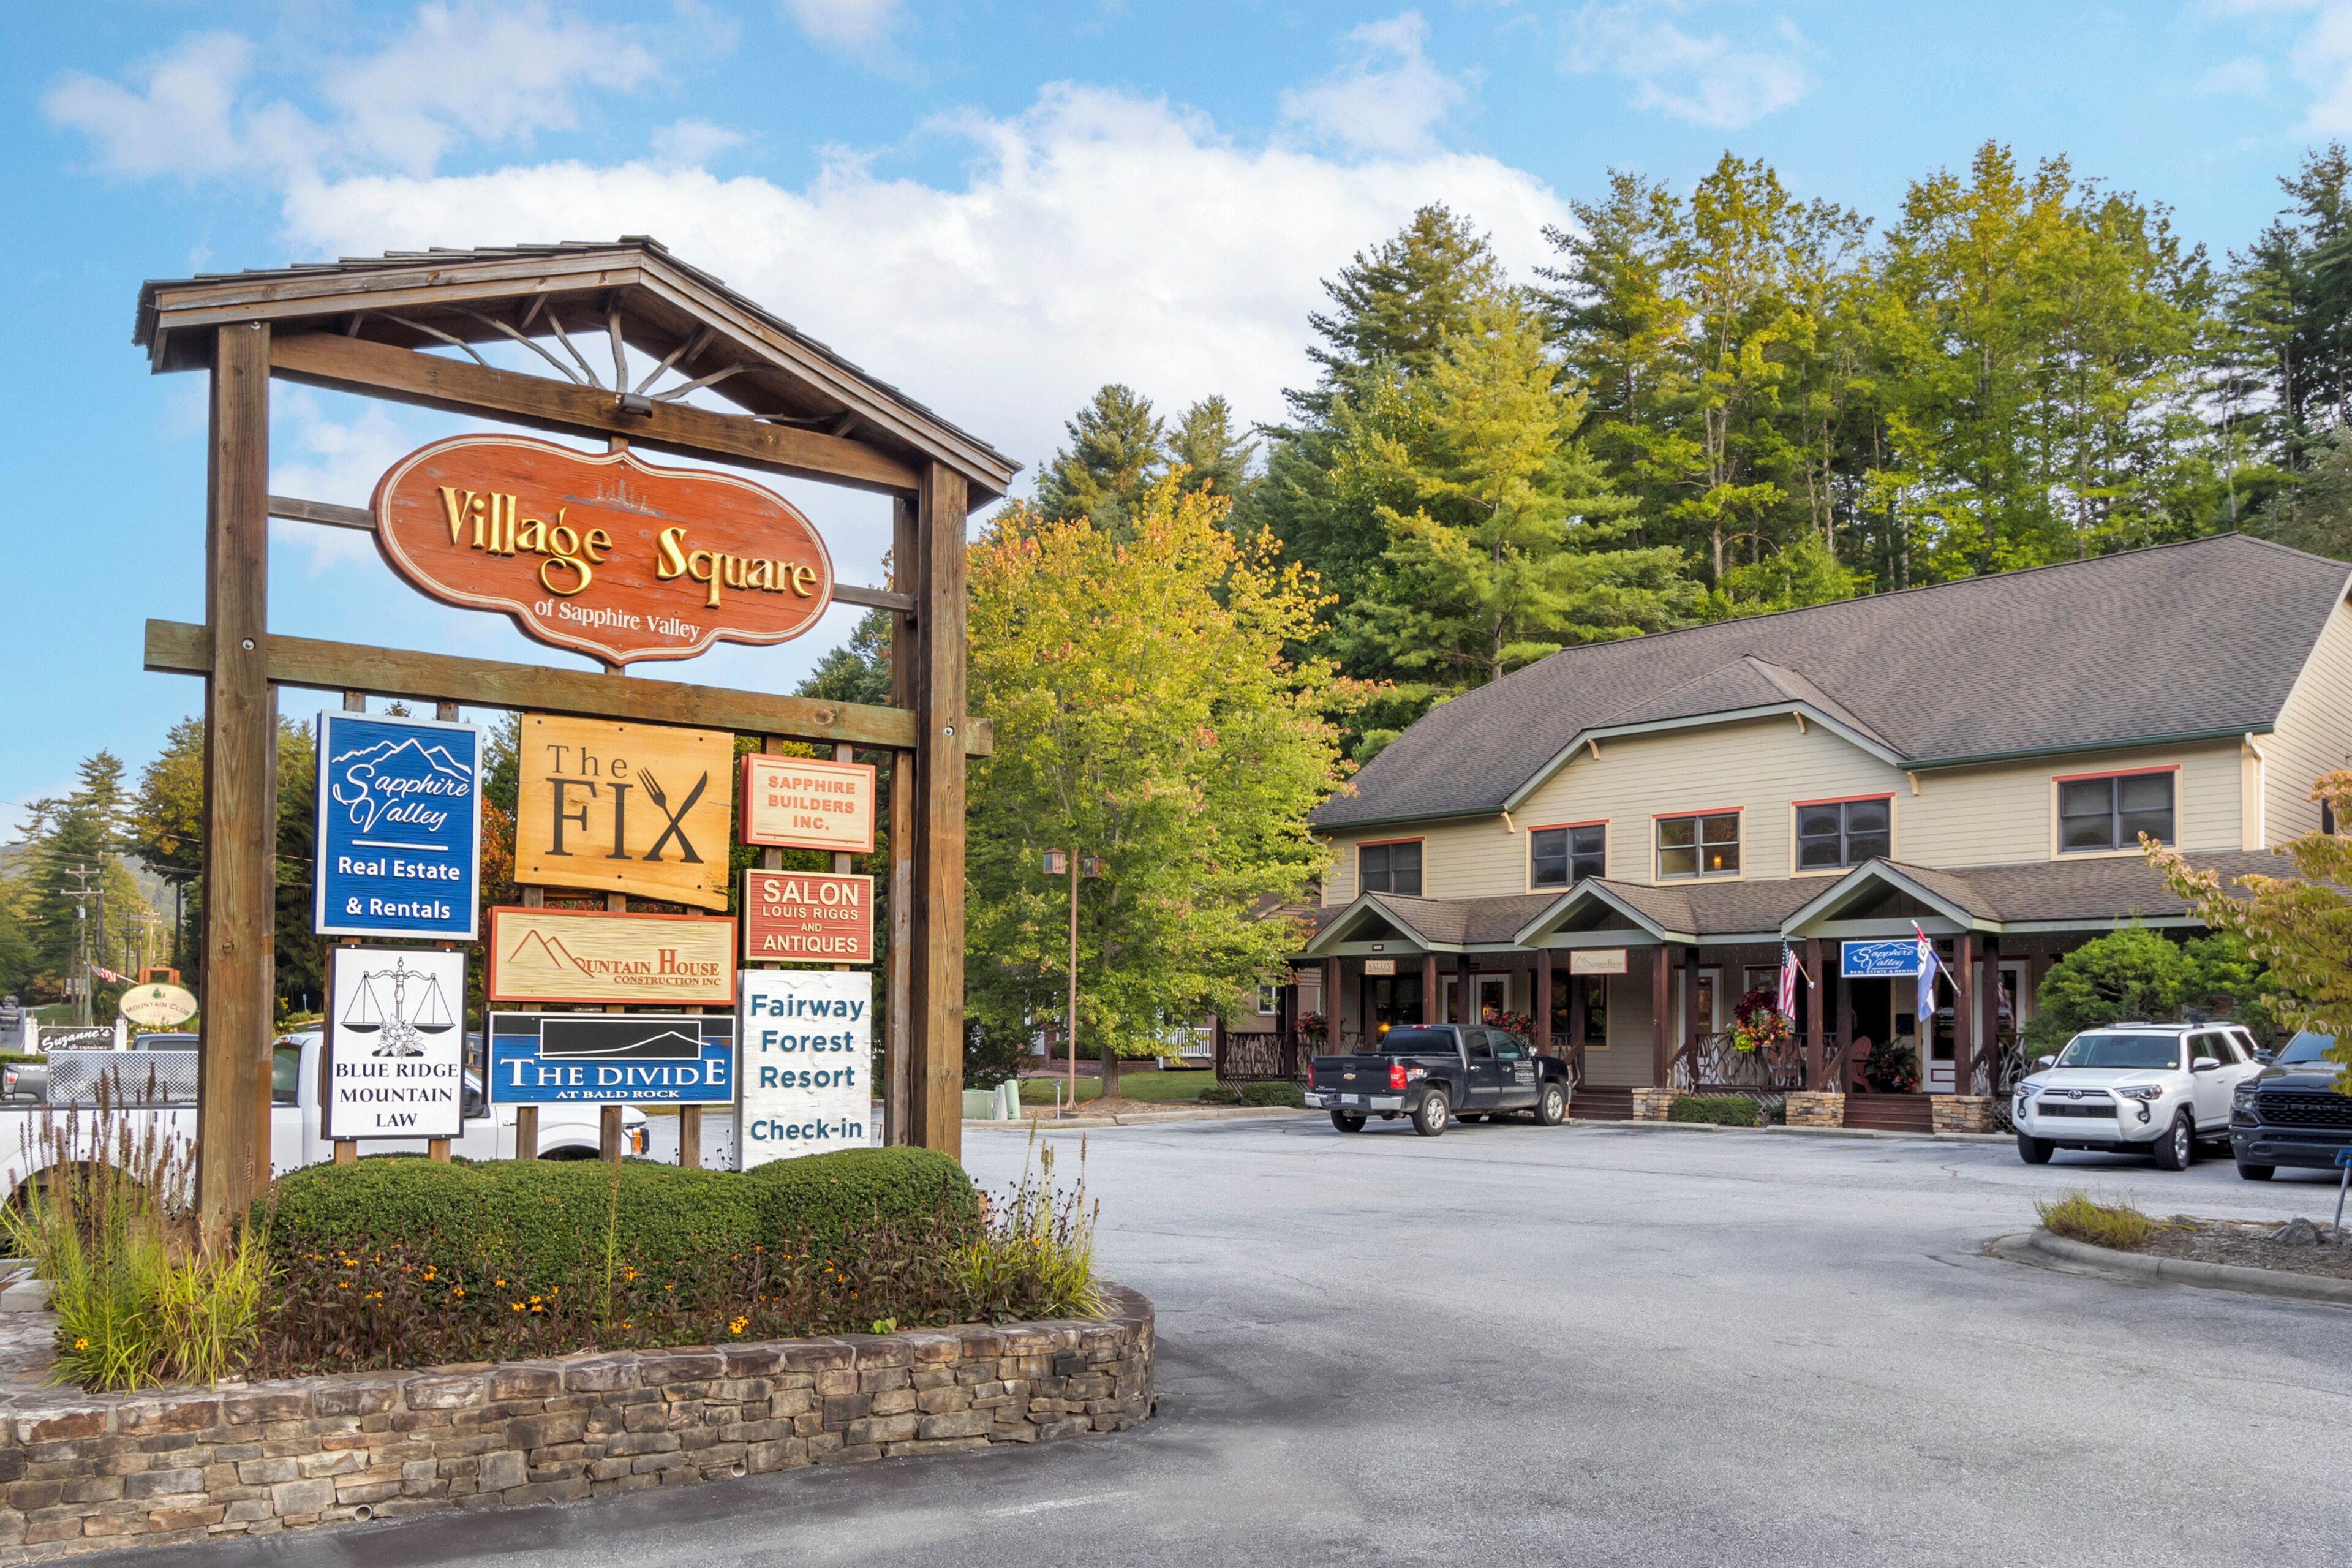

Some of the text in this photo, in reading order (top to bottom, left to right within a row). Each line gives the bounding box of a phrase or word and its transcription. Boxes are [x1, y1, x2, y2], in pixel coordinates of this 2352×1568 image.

[438, 486, 818, 608] Village Square
[534, 599, 700, 643] of Sapphire Valley
[546, 744, 628, 779] The
[333, 764, 470, 805] Sapphire
[769, 775, 856, 795] SAPPHIRE
[350, 796, 448, 834] Valley
[769, 794, 855, 814] BUILDERS
[545, 767, 708, 864] FIX
[793, 815, 830, 831] INC.
[338, 856, 461, 881] Real Estate
[763, 878, 859, 907] SALON
[345, 897, 451, 919] & Rentals
[762, 905, 859, 921] LOUIS RIGGS
[801, 922, 823, 933] AND
[762, 935, 859, 954] ANTIQUES
[1853, 948, 1914, 963] Sapphire
[658, 948, 720, 976] HOUSE
[1860, 957, 1904, 970] Valley
[614, 976, 721, 986] CONSTRUCTION INC
[126, 1002, 191, 1016] MOUNTAIN CLUB
[751, 994, 865, 1022] Fairway
[41, 1028, 111, 1052] Suzanne's
[761, 1030, 854, 1052] Forest
[336, 1063, 458, 1078] BLUE RIDGE
[500, 1058, 726, 1087] THE DIVIDE
[760, 1066, 856, 1088] Resort
[340, 1088, 453, 1102] MOUNTAIN
[556, 1090, 580, 1099] AT
[583, 1090, 630, 1099] BALD
[375, 1113, 418, 1128] LAW
[750, 1118, 862, 1140] Check-in
